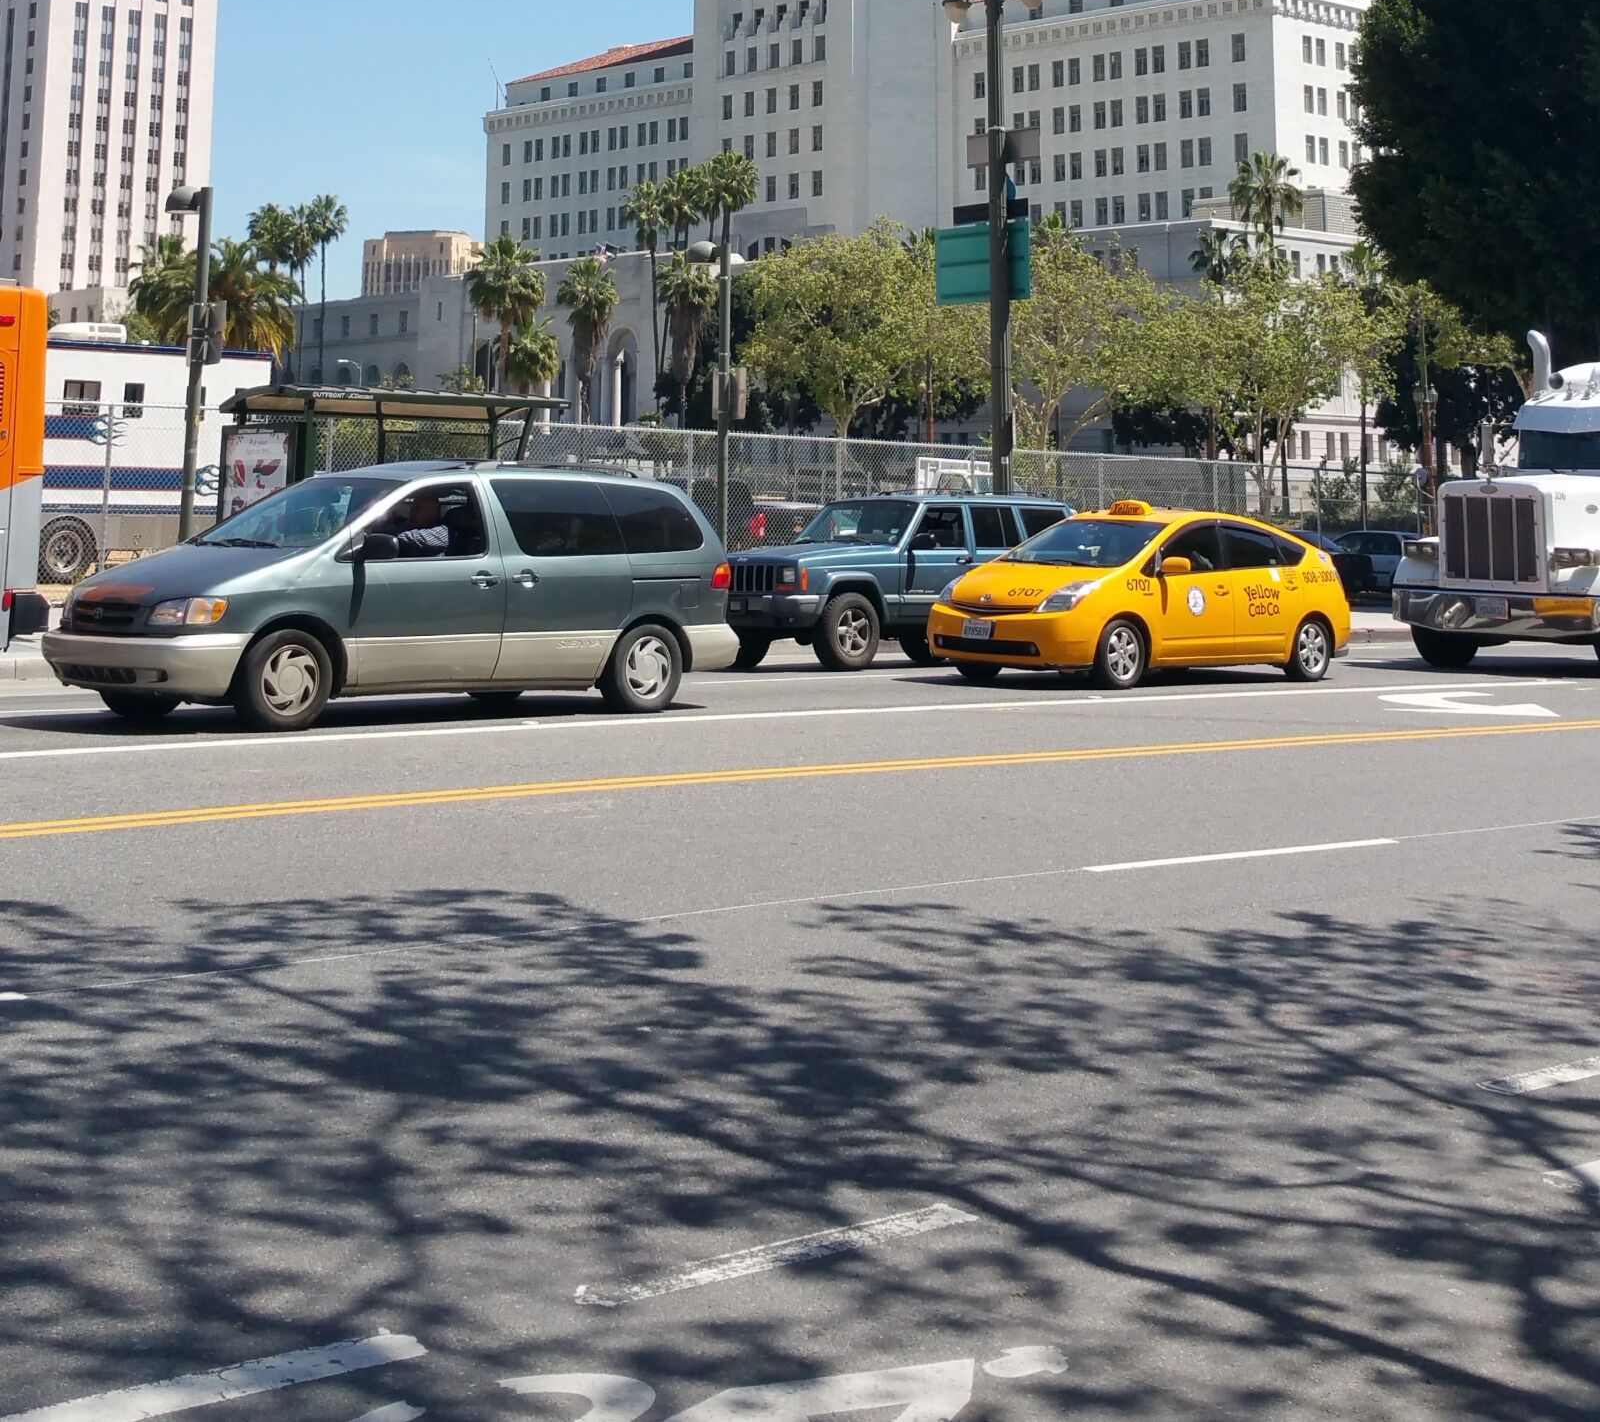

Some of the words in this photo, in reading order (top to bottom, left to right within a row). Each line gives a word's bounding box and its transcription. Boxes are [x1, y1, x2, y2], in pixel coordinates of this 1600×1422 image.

[312, 391, 345, 399] OUTFRONT
[1114, 503, 1141, 515] Yellow
[1126, 578, 1151, 592] 6707
[1007, 587, 1044, 598] 6707
[1243, 584, 1280, 602] Yellow
[1248, 602, 1267, 618] Cab
